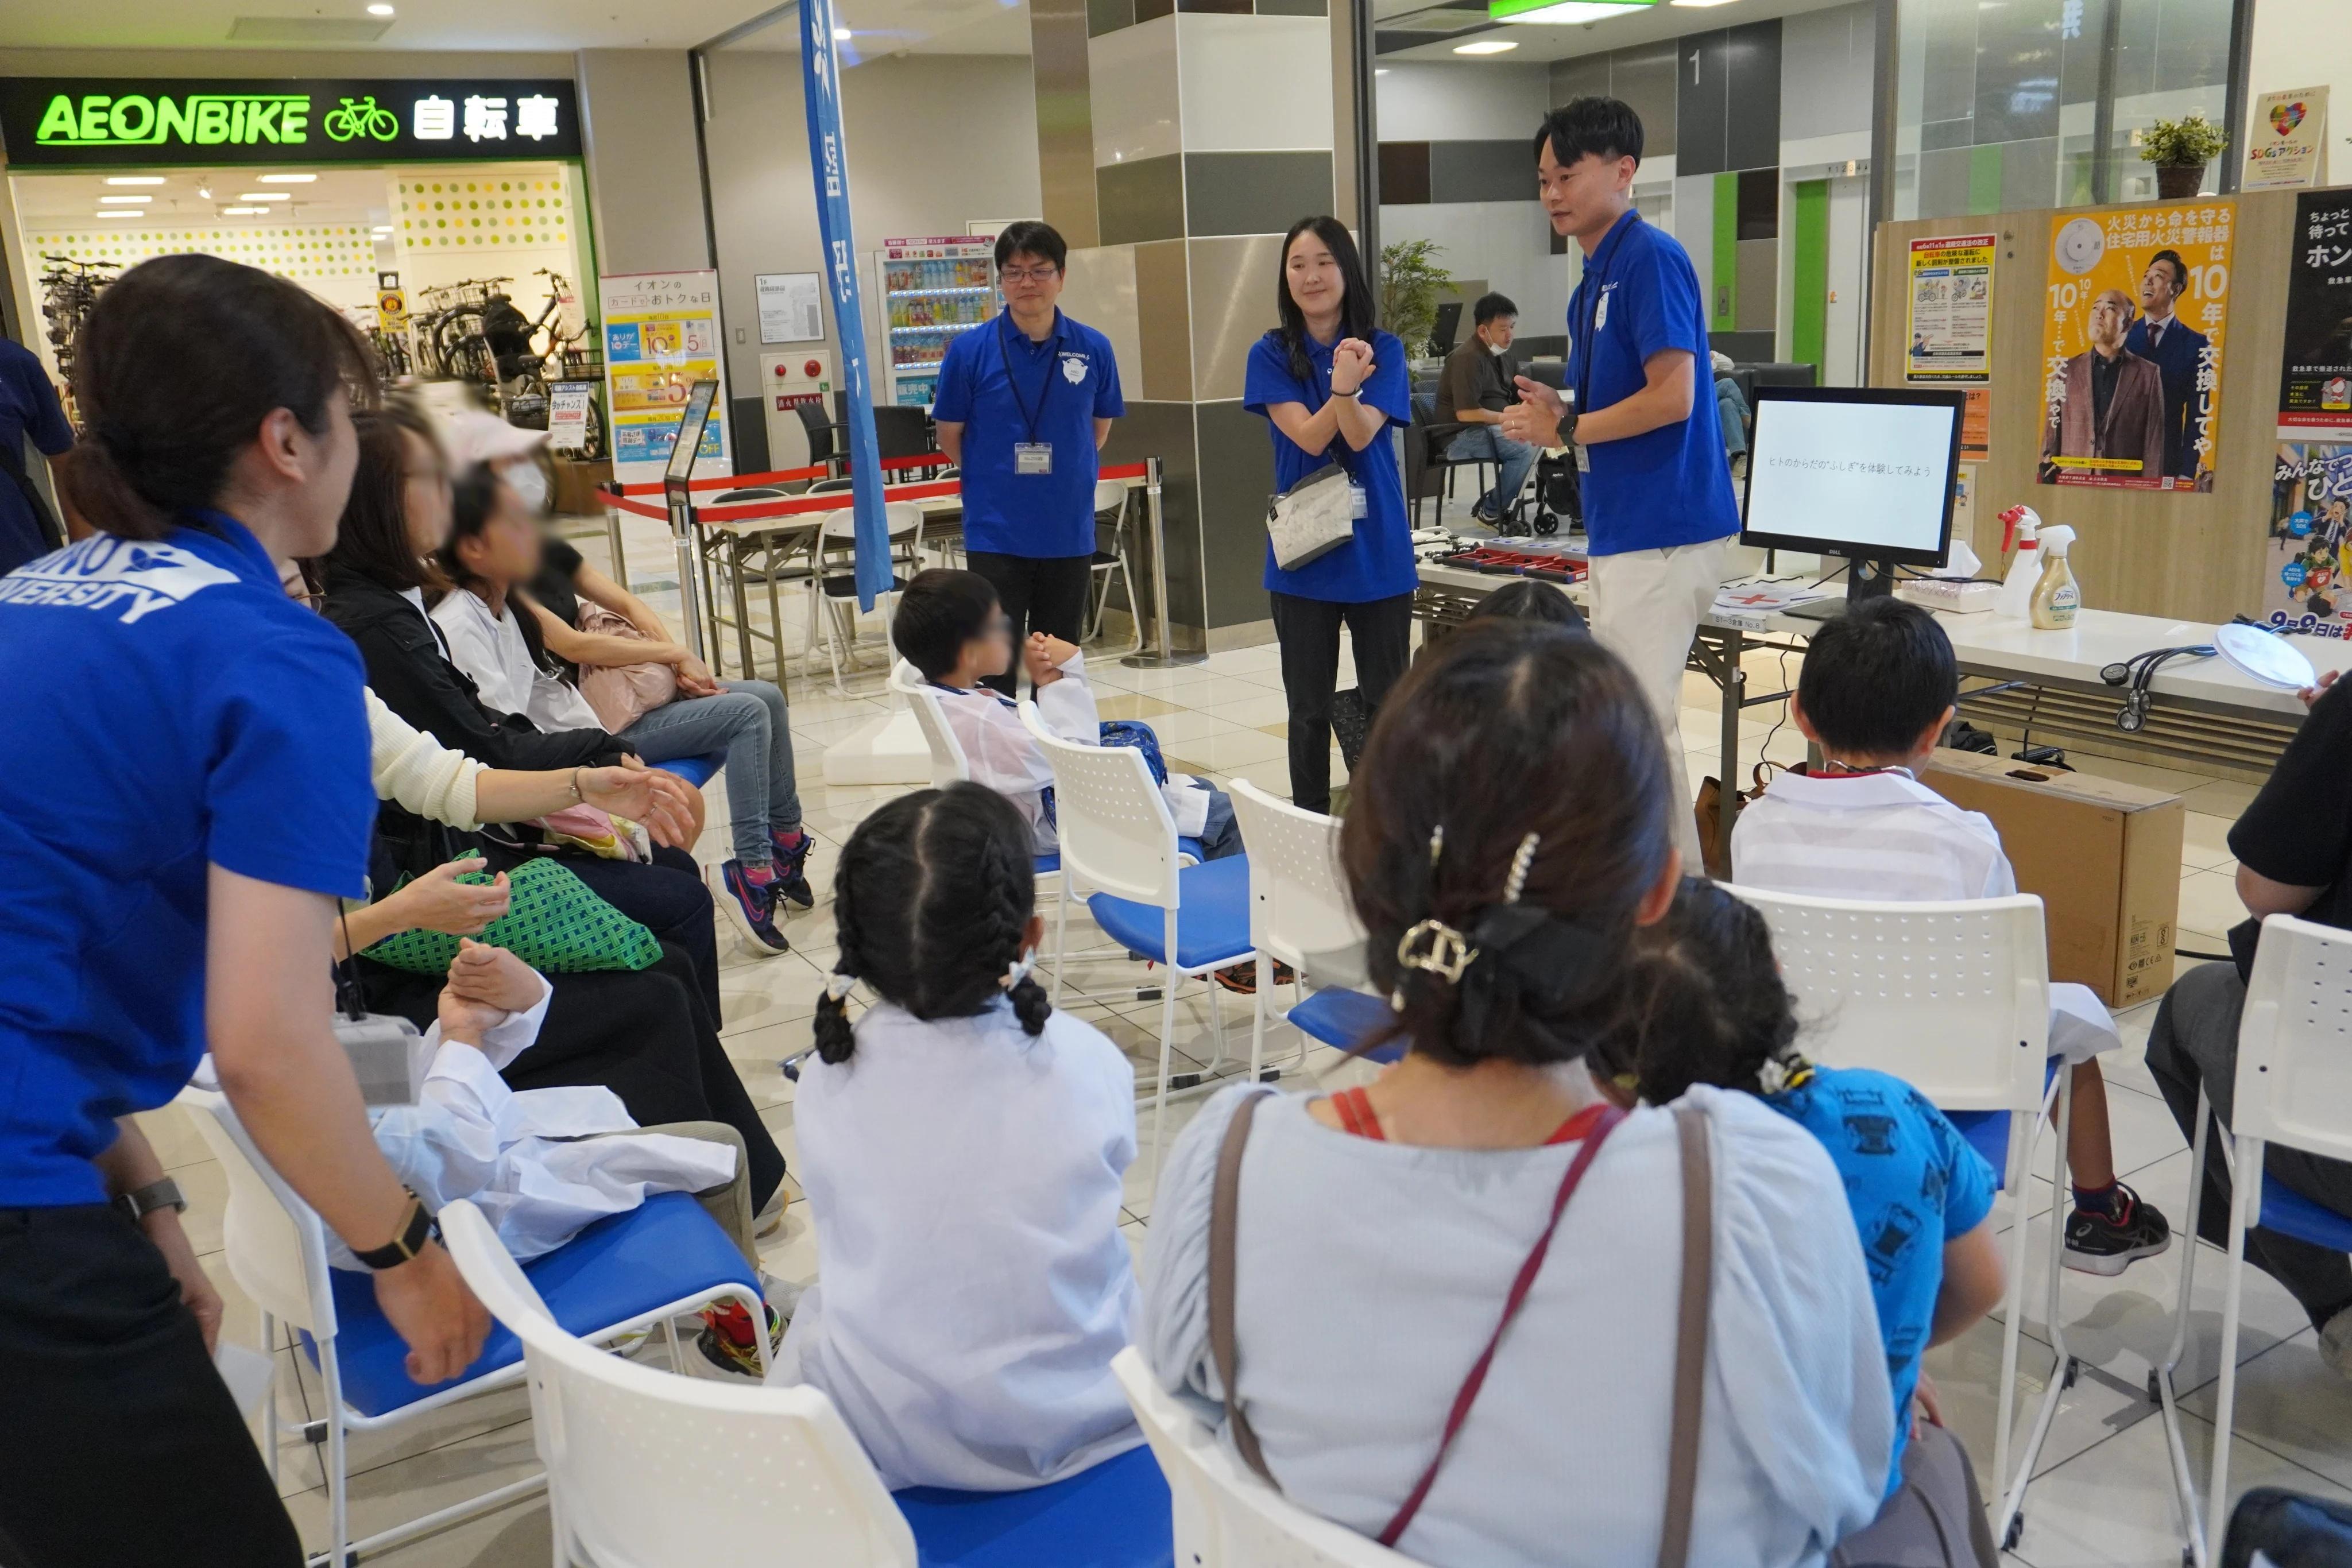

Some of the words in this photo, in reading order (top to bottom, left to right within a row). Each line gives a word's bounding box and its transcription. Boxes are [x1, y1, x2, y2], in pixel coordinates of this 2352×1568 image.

[1689, 49, 1700, 84] 1
[36, 94, 310, 145] AEONBIKE
[413, 94, 559, 142] 自転車
[2107, 207, 2231, 231] 火災から命を守る
[2309, 208, 2350, 223] ちょっと
[2106, 224, 2230, 250] 住宅用火災警報器
[2308, 221, 2350, 241] 待って
[633, 280, 682, 291] イオンの
[698, 444, 719, 455] OFF
[1745, 621, 1760, 629] No.8
